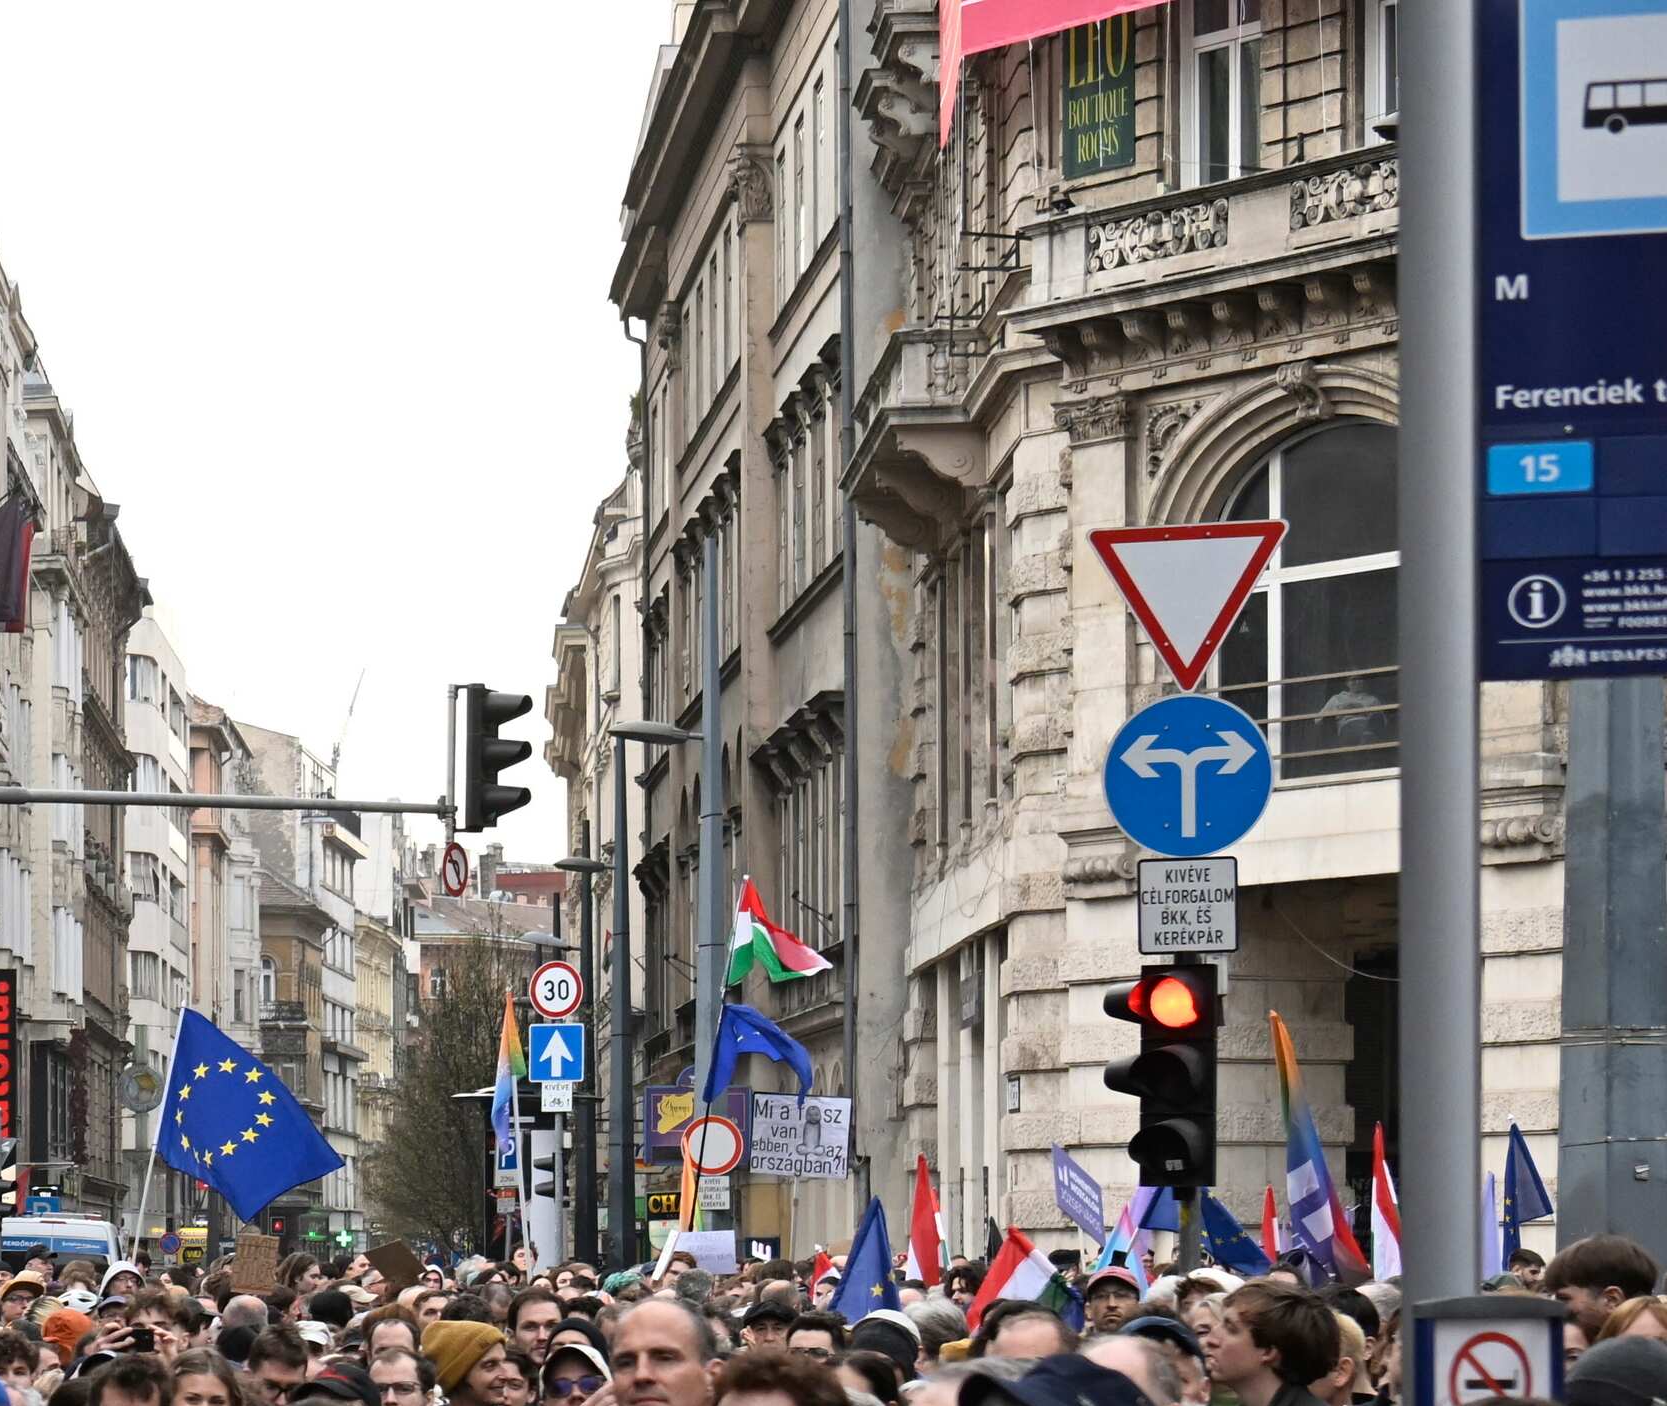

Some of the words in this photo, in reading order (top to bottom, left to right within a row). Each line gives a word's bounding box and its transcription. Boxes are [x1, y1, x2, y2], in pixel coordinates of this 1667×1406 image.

[1069, 86, 1129, 130] BOUTIQUE
[1078, 125, 1120, 164] ROOMS
[1495, 274, 1529, 300] M
[1495, 377, 1644, 410] Ferenciek
[1519, 453, 1561, 483] 15
[1589, 647, 1667, 662] BUDAPES
[1165, 865, 1211, 883] KIVÉVE
[1141, 886, 1235, 905] CÉLFORGALOM
[1196, 905, 1212, 924] ÉS
[1154, 926, 1224, 946] KERÉKPÁR
[543, 979, 570, 1002] 30
[754, 1099, 774, 1119] Mi
[779, 1105, 790, 1121] a
[770, 1124, 797, 1140] van
